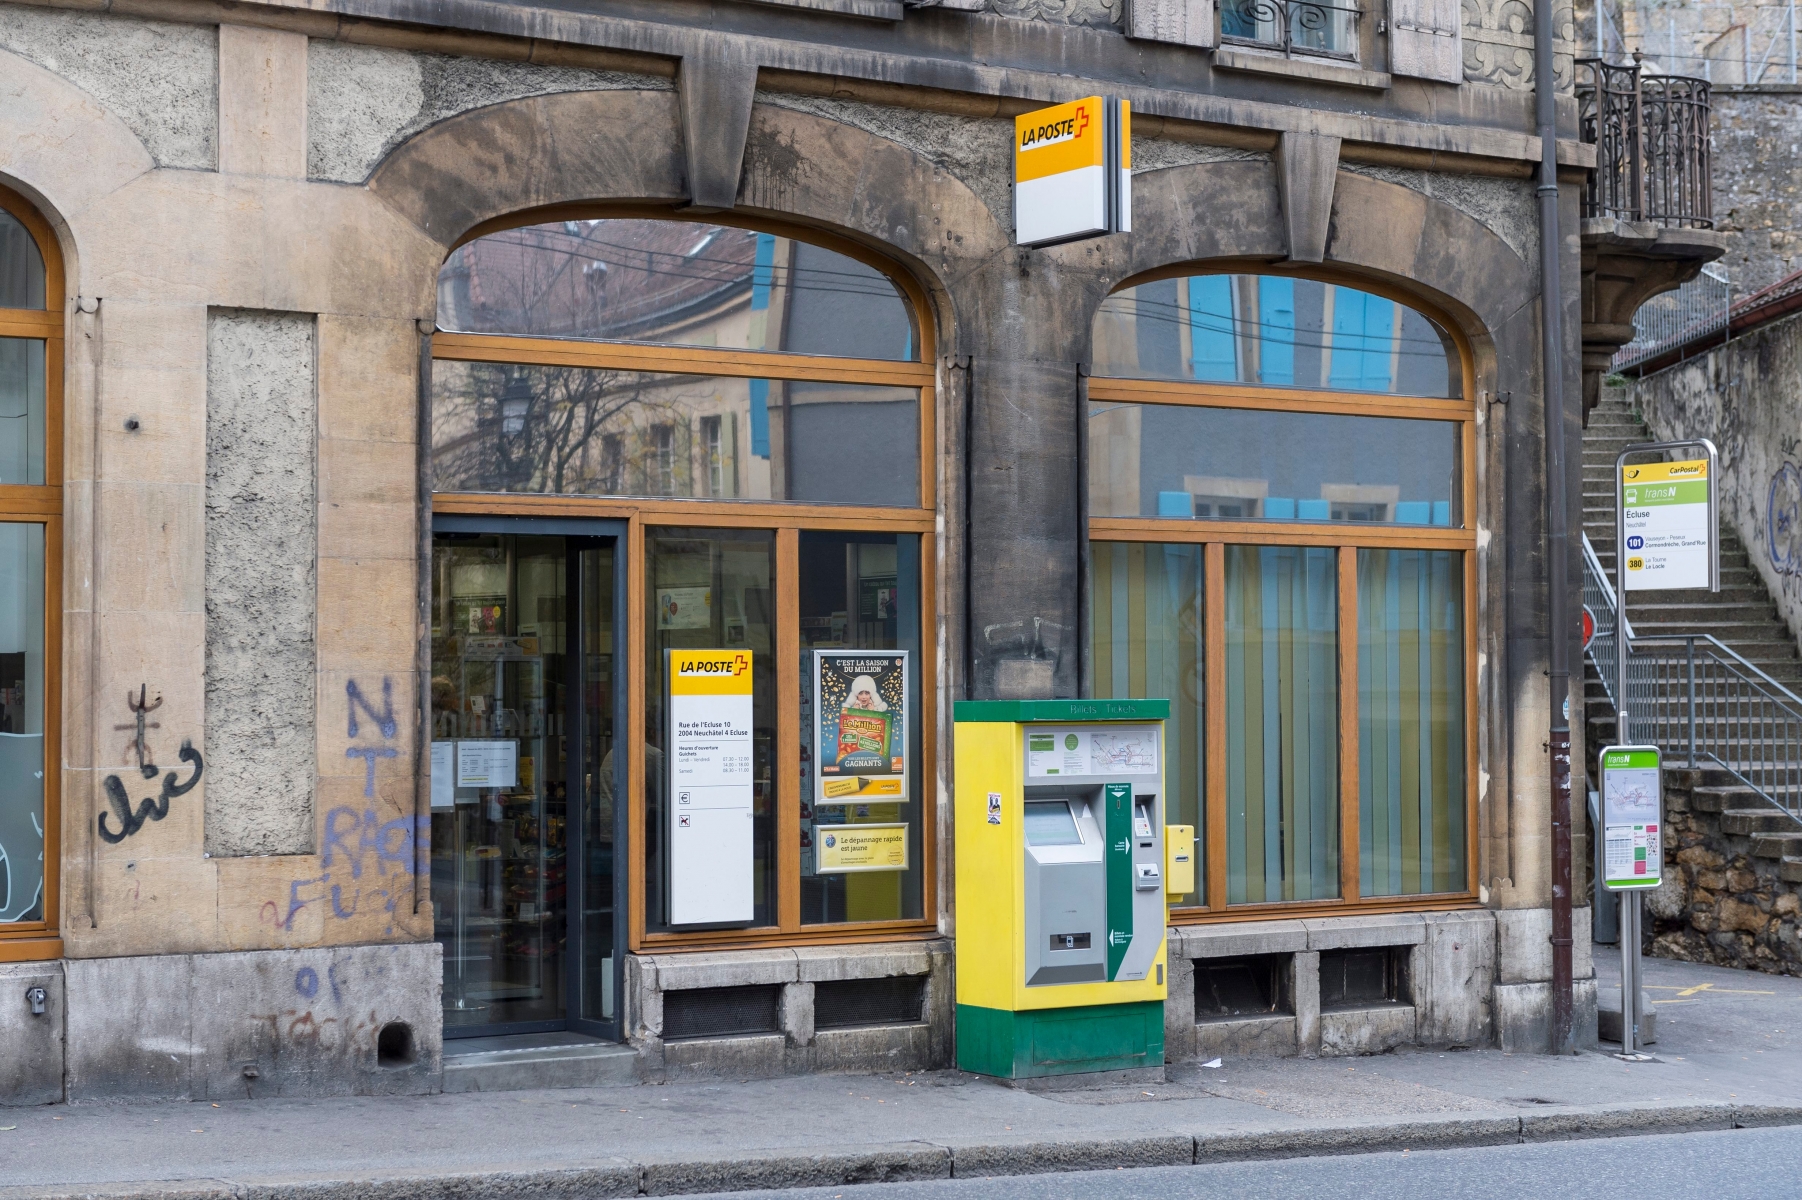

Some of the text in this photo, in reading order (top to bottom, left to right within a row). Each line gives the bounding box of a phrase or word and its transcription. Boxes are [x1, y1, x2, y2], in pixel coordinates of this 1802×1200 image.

[1022, 118, 1074, 146] LA POSTE
[1670, 465, 1699, 474] CarPostal
[1644, 486, 1676, 498] transN
[1626, 509, 1650, 518] Écluse
[1628, 538, 1641, 547] 101
[1629, 560, 1642, 568] 380
[680, 662, 733, 672] LA POSTE
[1070, 704, 1136, 714] Billets Tickets
[843, 719, 882, 730] Le Million
[1607, 754, 1630, 763] transN
[849, 836, 882, 844] dépannage
